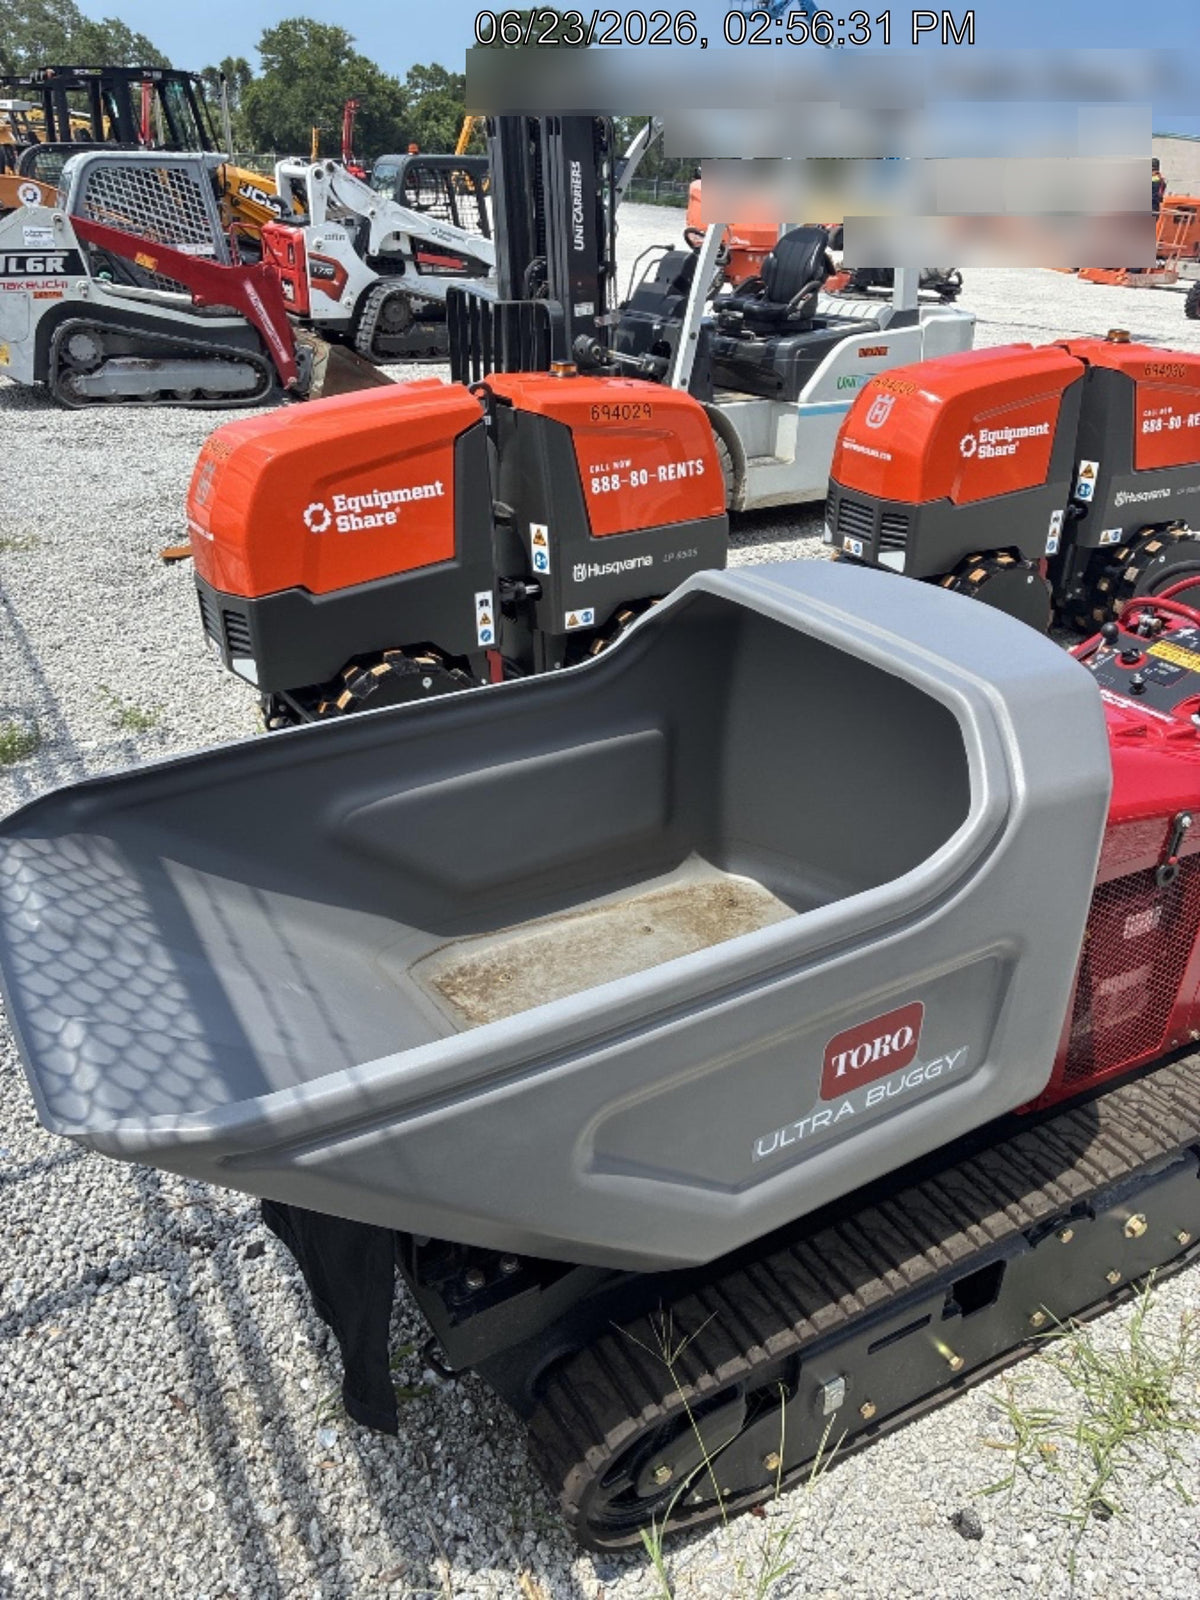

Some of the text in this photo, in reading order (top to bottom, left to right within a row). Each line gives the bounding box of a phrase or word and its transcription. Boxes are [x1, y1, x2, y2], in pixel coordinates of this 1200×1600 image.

[591, 404, 651, 421] 694029
[978, 422, 1050, 443] Equipment
[977, 442, 1016, 459] Share
[590, 458, 632, 474] CALL NOW
[591, 458, 704, 494] 888-80-RENTS
[332, 480, 444, 513] Equipment
[336, 511, 396, 532] Share
[588, 554, 653, 578] Husqvarna
[832, 1025, 914, 1078] TORO
[756, 1046, 970, 1157] ULTRA BUGGY
